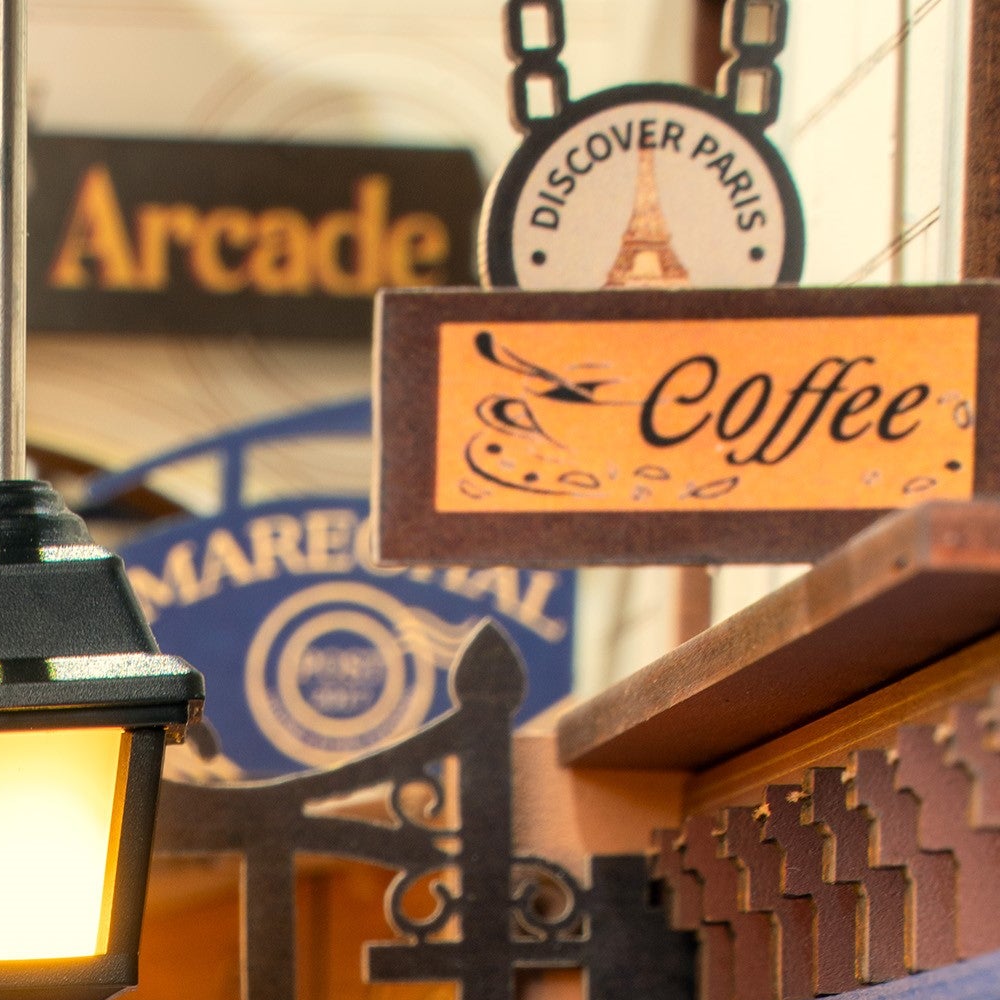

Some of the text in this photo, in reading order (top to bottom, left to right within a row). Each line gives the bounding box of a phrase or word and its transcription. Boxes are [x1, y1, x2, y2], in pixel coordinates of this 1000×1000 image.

[48, 164, 452, 297] Arcade
[531, 119, 767, 232] DISCOVER PARIS
[639, 353, 930, 466] Coffee
[130, 508, 566, 643] MARECAL
